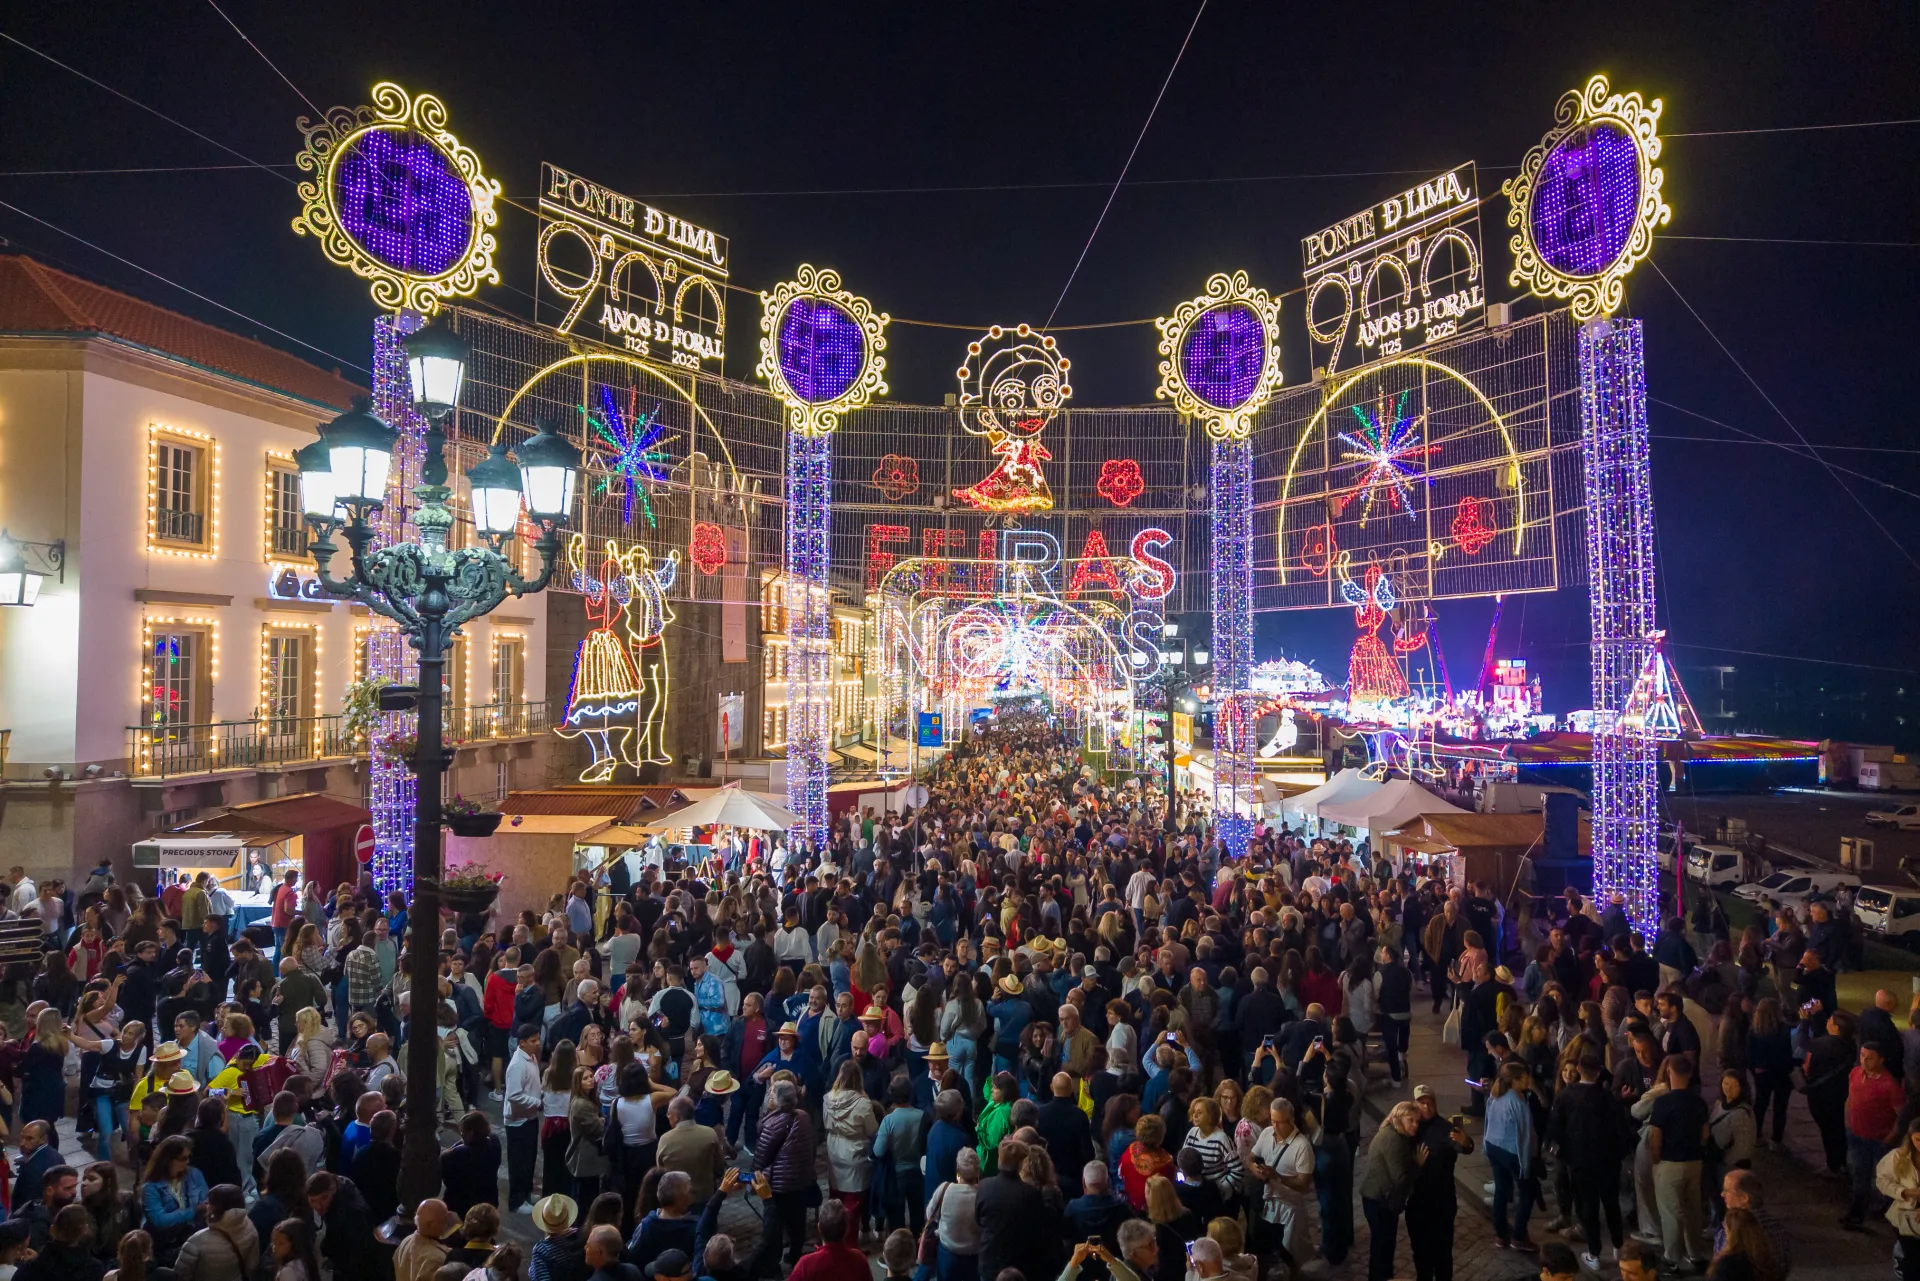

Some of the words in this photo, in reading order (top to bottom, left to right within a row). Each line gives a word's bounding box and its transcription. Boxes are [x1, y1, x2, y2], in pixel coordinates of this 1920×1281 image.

[548, 167, 635, 227] PONTE
[1306, 209, 1376, 265] PONTE
[599, 304, 651, 338] ANOS
[672, 326, 724, 359] FORAL
[1356, 312, 1402, 347] ANOS
[1423, 285, 1484, 325] FORAL
[1379, 338, 1402, 357] 1125
[1425, 320, 1456, 343] 2025
[624, 335, 649, 355] 1125
[672, 350, 700, 370] 2025
[868, 524, 1177, 601] FEIRAS
